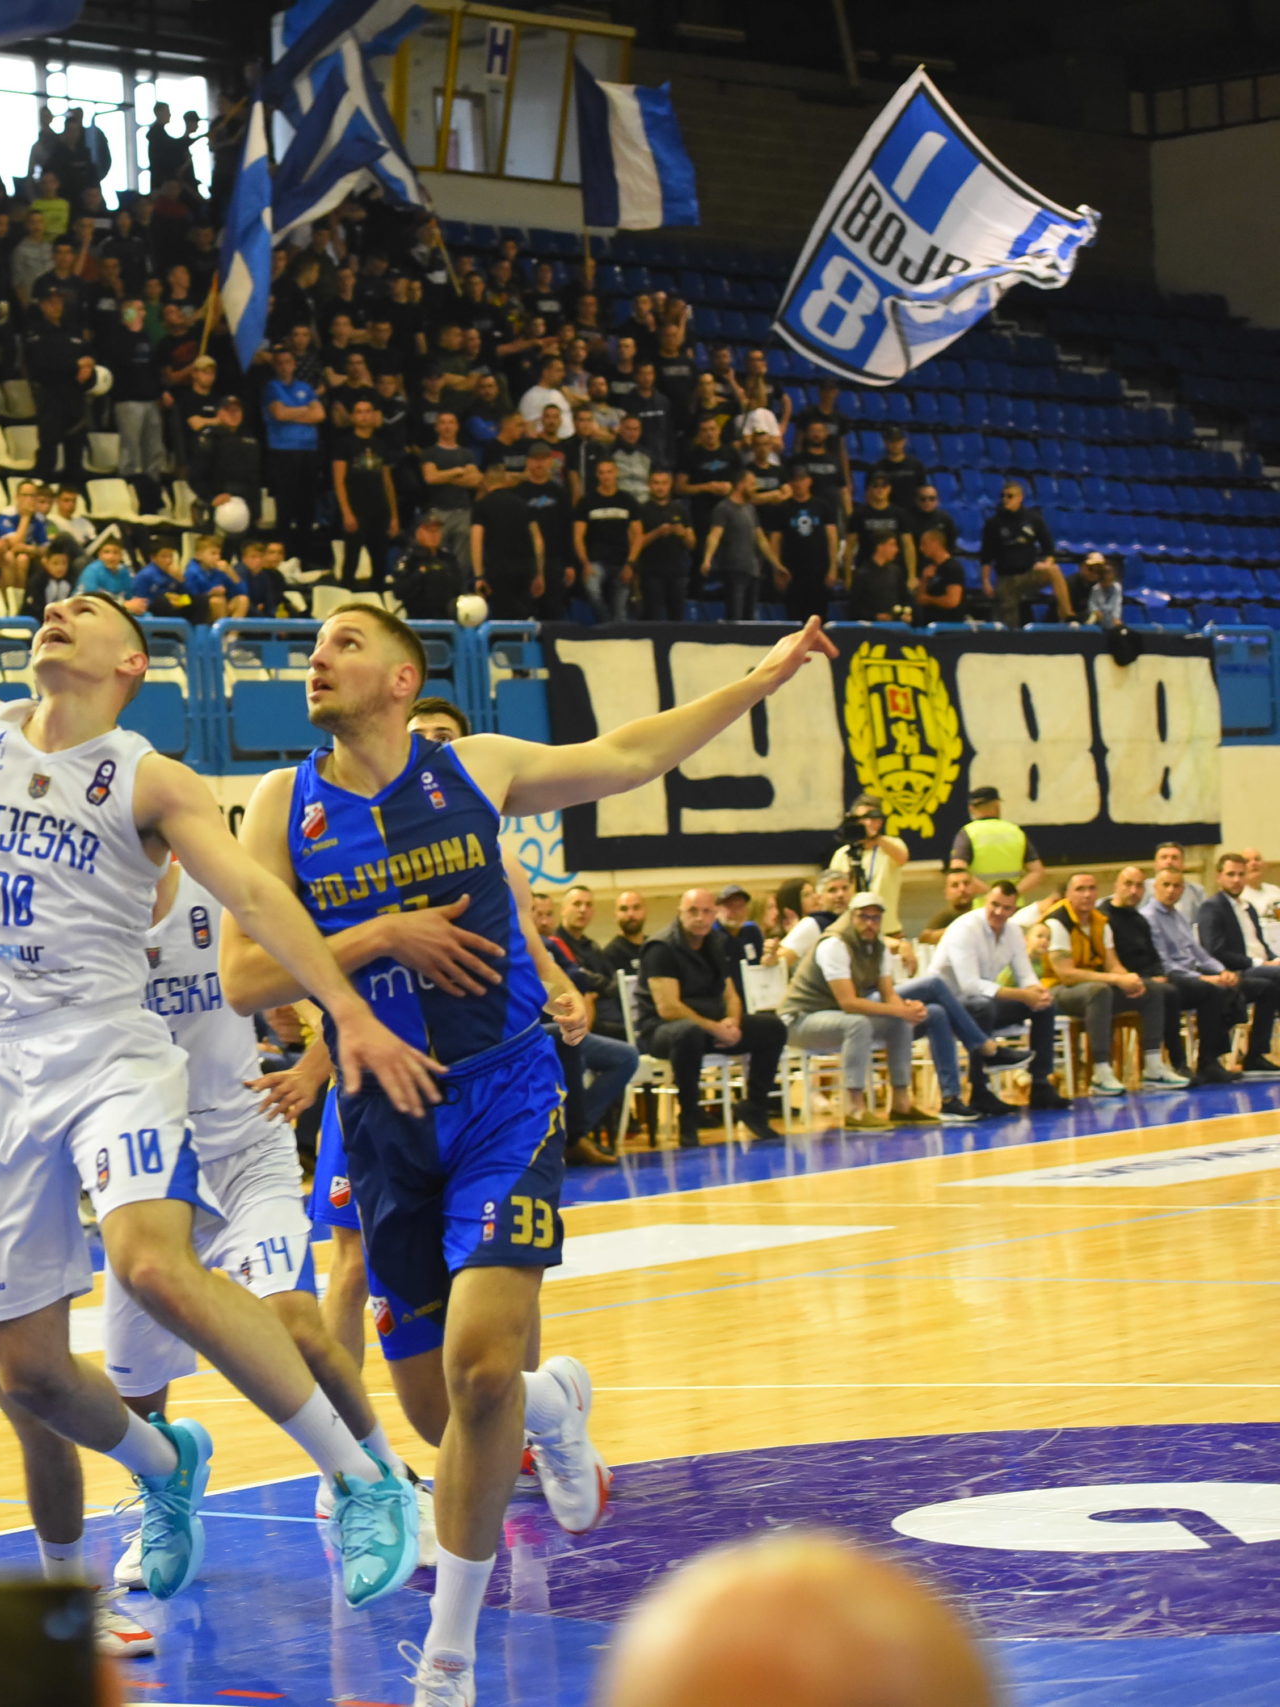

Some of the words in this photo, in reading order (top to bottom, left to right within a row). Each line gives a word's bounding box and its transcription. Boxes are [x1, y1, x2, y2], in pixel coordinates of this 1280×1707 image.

[800, 255, 880, 350] 8
[309, 832, 487, 911] VOJVODINA
[118, 1128, 164, 1177] 10
[510, 1195, 554, 1249] 33
[256, 1236, 293, 1275] 14
